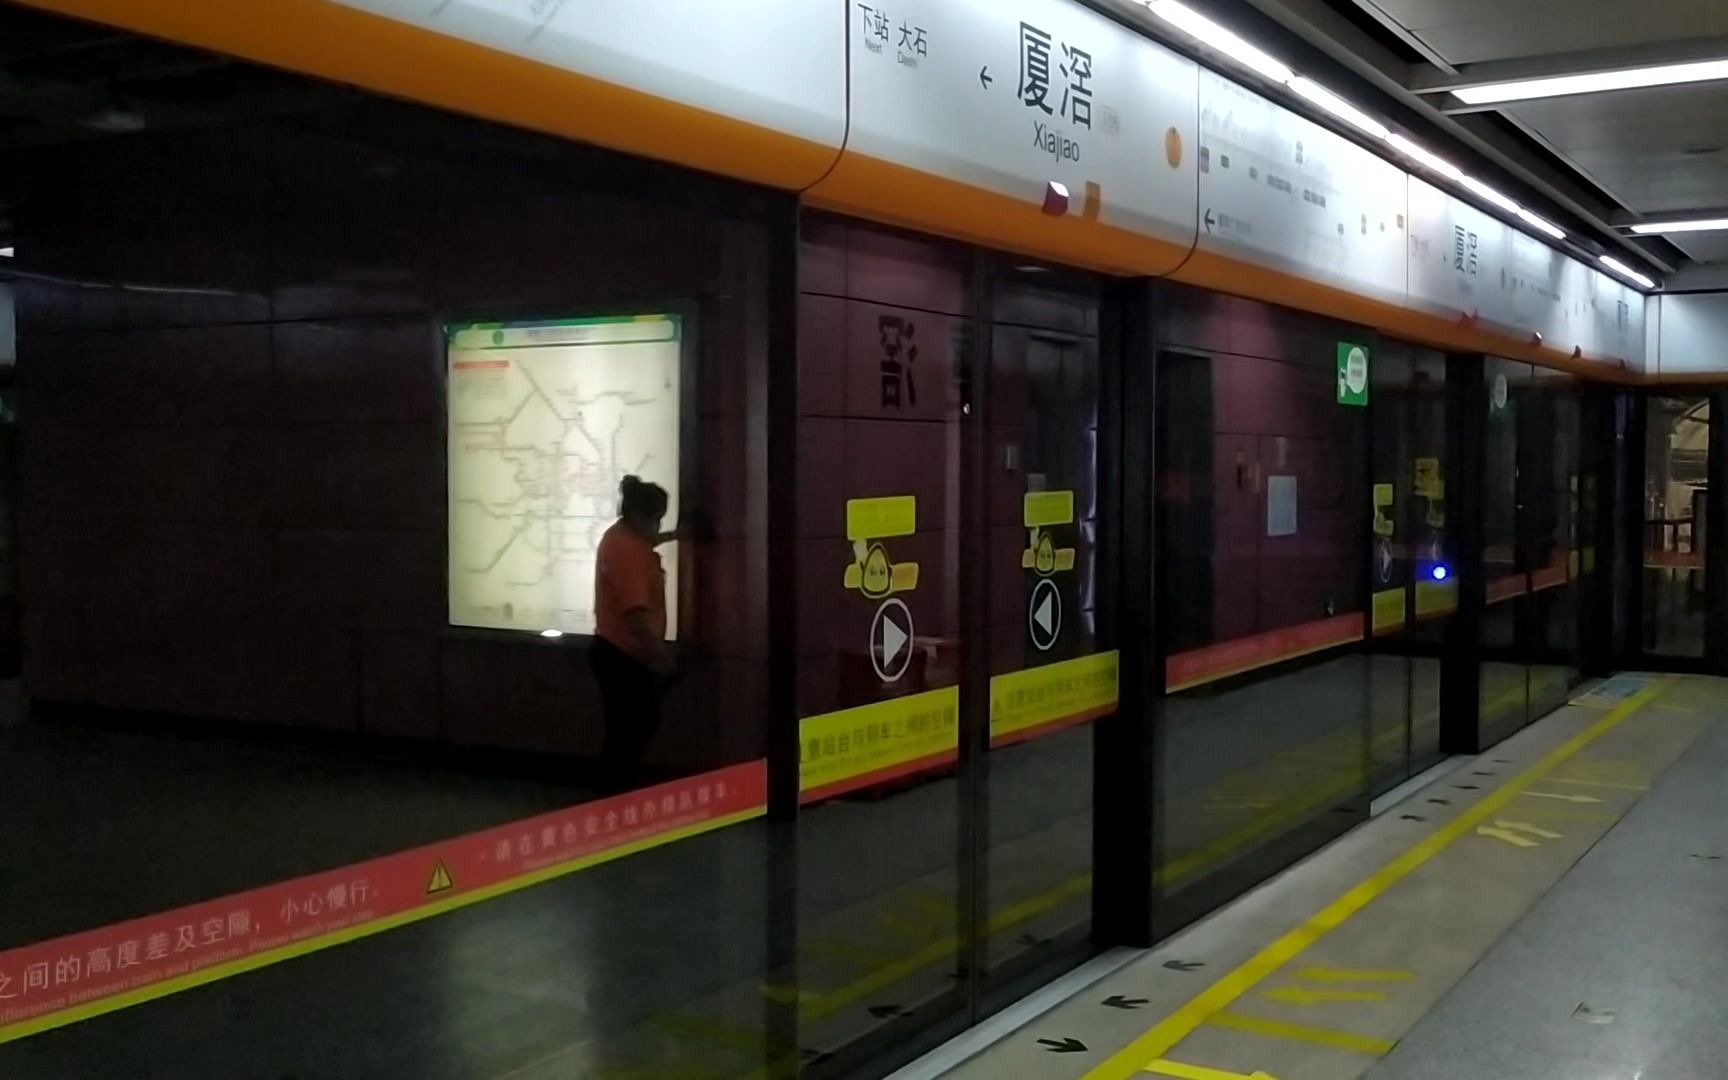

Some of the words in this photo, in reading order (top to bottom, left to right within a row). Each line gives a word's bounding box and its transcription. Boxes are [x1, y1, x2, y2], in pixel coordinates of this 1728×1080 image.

[858, 3, 889, 41] 下站
[898, 20, 927, 57] 大石
[1017, 21, 1092, 131] 厦滘
[1033, 120, 1080, 164] Xiajiao
